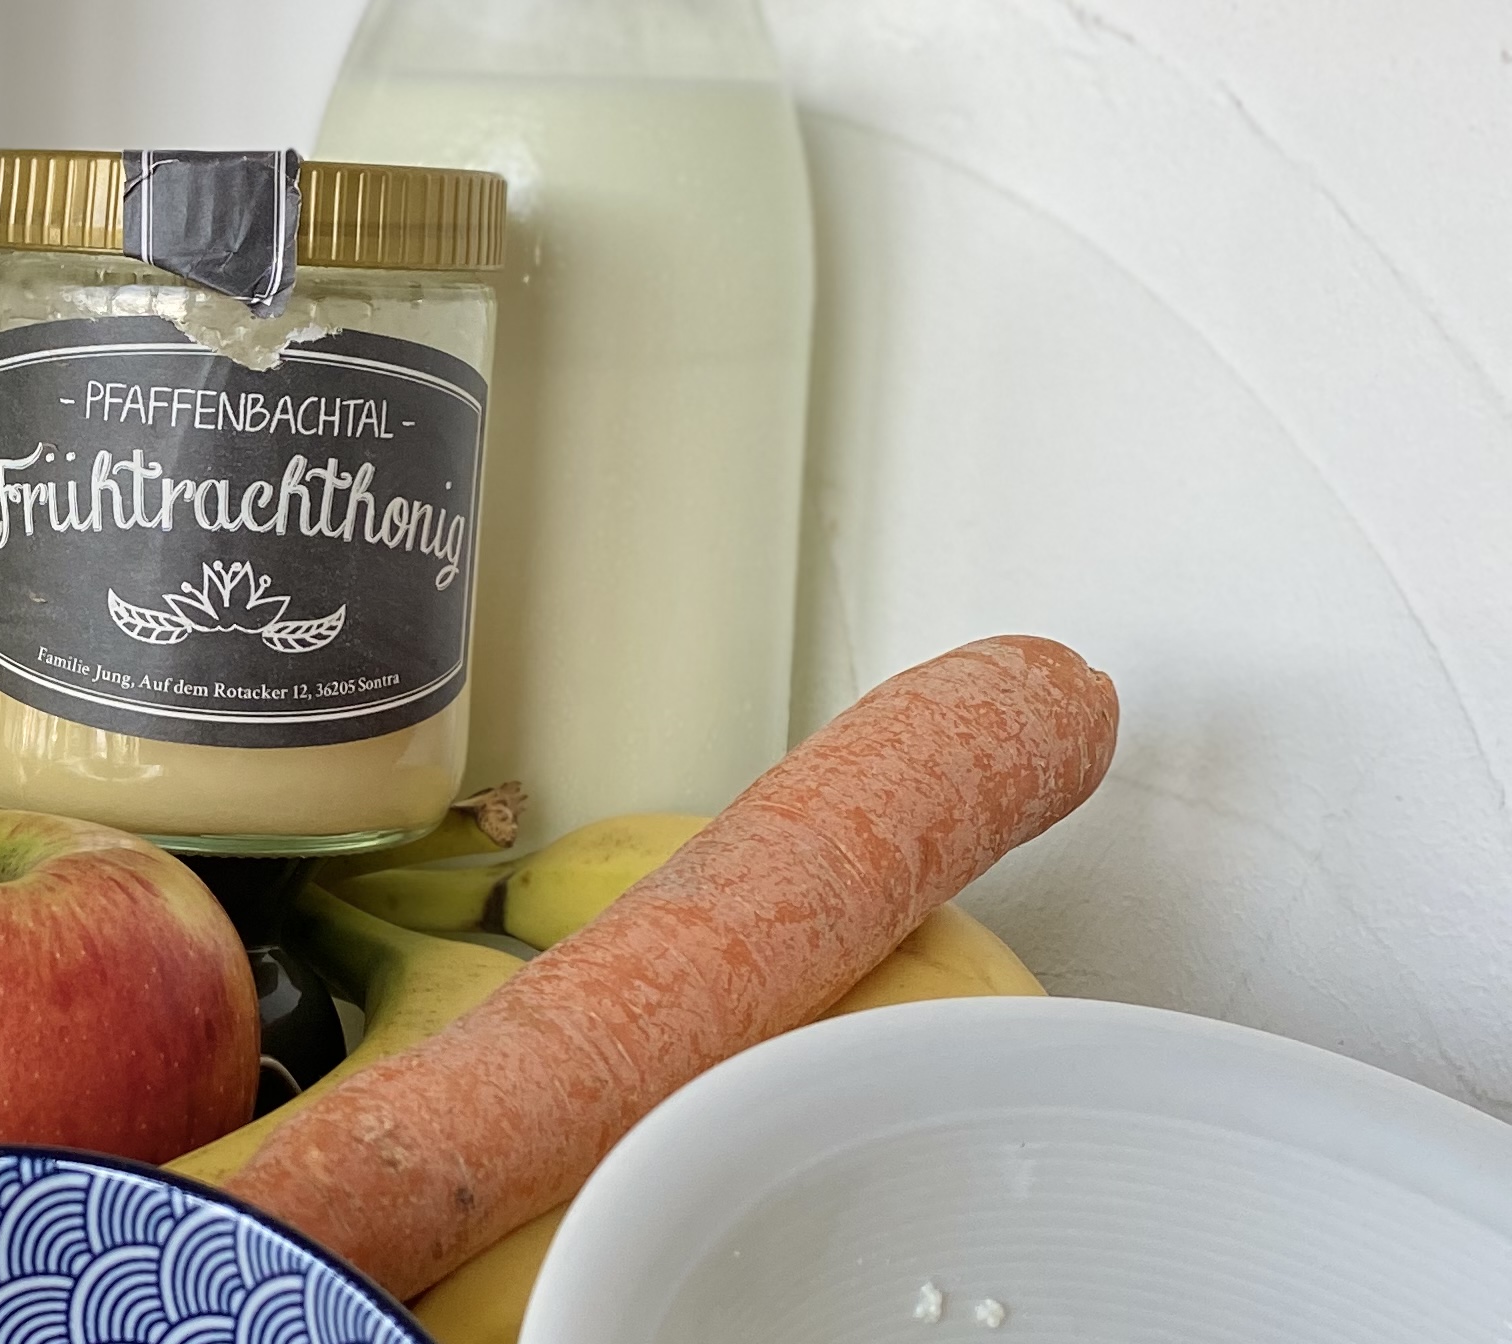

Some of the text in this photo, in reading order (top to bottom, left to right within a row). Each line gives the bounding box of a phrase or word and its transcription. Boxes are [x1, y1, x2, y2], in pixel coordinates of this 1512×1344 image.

[38, 645, 401, 702] Familie Jung, Auf dem Rotacker 12, 36205 Sontra
